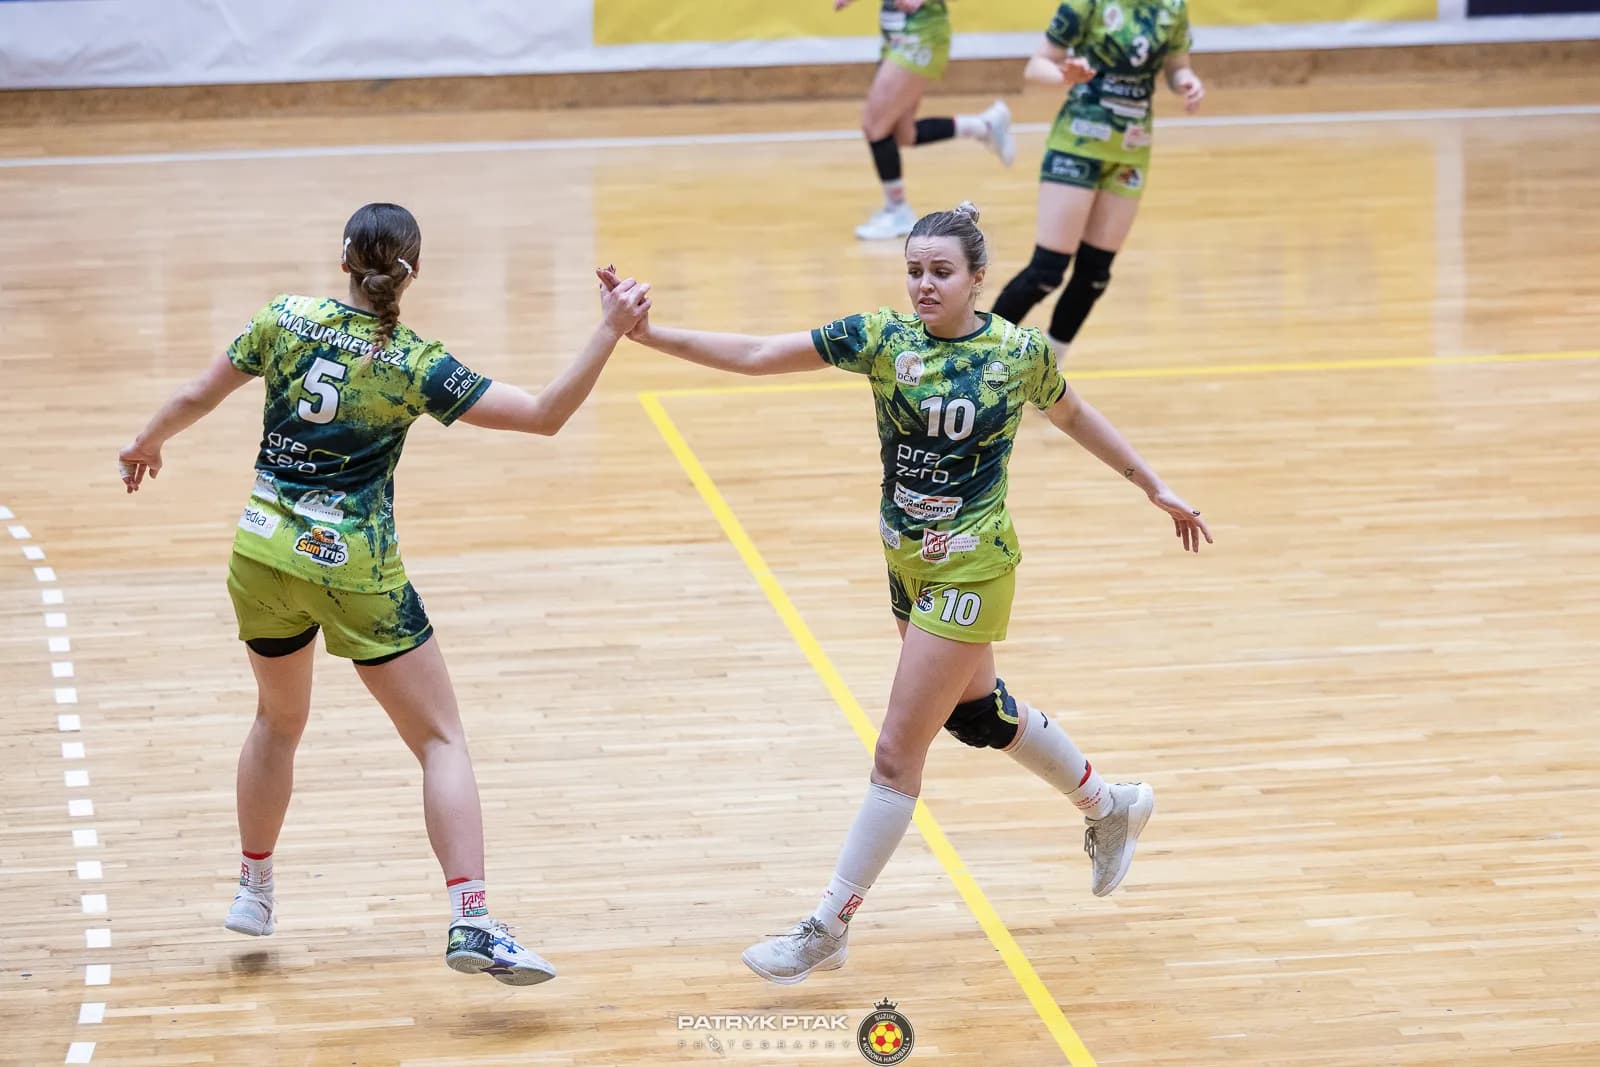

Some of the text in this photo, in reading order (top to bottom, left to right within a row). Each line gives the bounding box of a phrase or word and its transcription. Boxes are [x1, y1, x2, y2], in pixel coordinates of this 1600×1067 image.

[1130, 35, 1150, 67] 3
[276, 312, 405, 367] MAZURKIEWICZ
[297, 357, 347, 424] 5
[443, 366, 466, 392] pre
[897, 373, 917, 384] DCM
[919, 396, 976, 441] 10
[267, 431, 308, 455] pre
[896, 443, 941, 465] pre
[266, 449, 317, 474] zero
[896, 462, 949, 484] zero
[296, 538, 346, 563] SunTrip
[939, 587, 982, 627] 10
